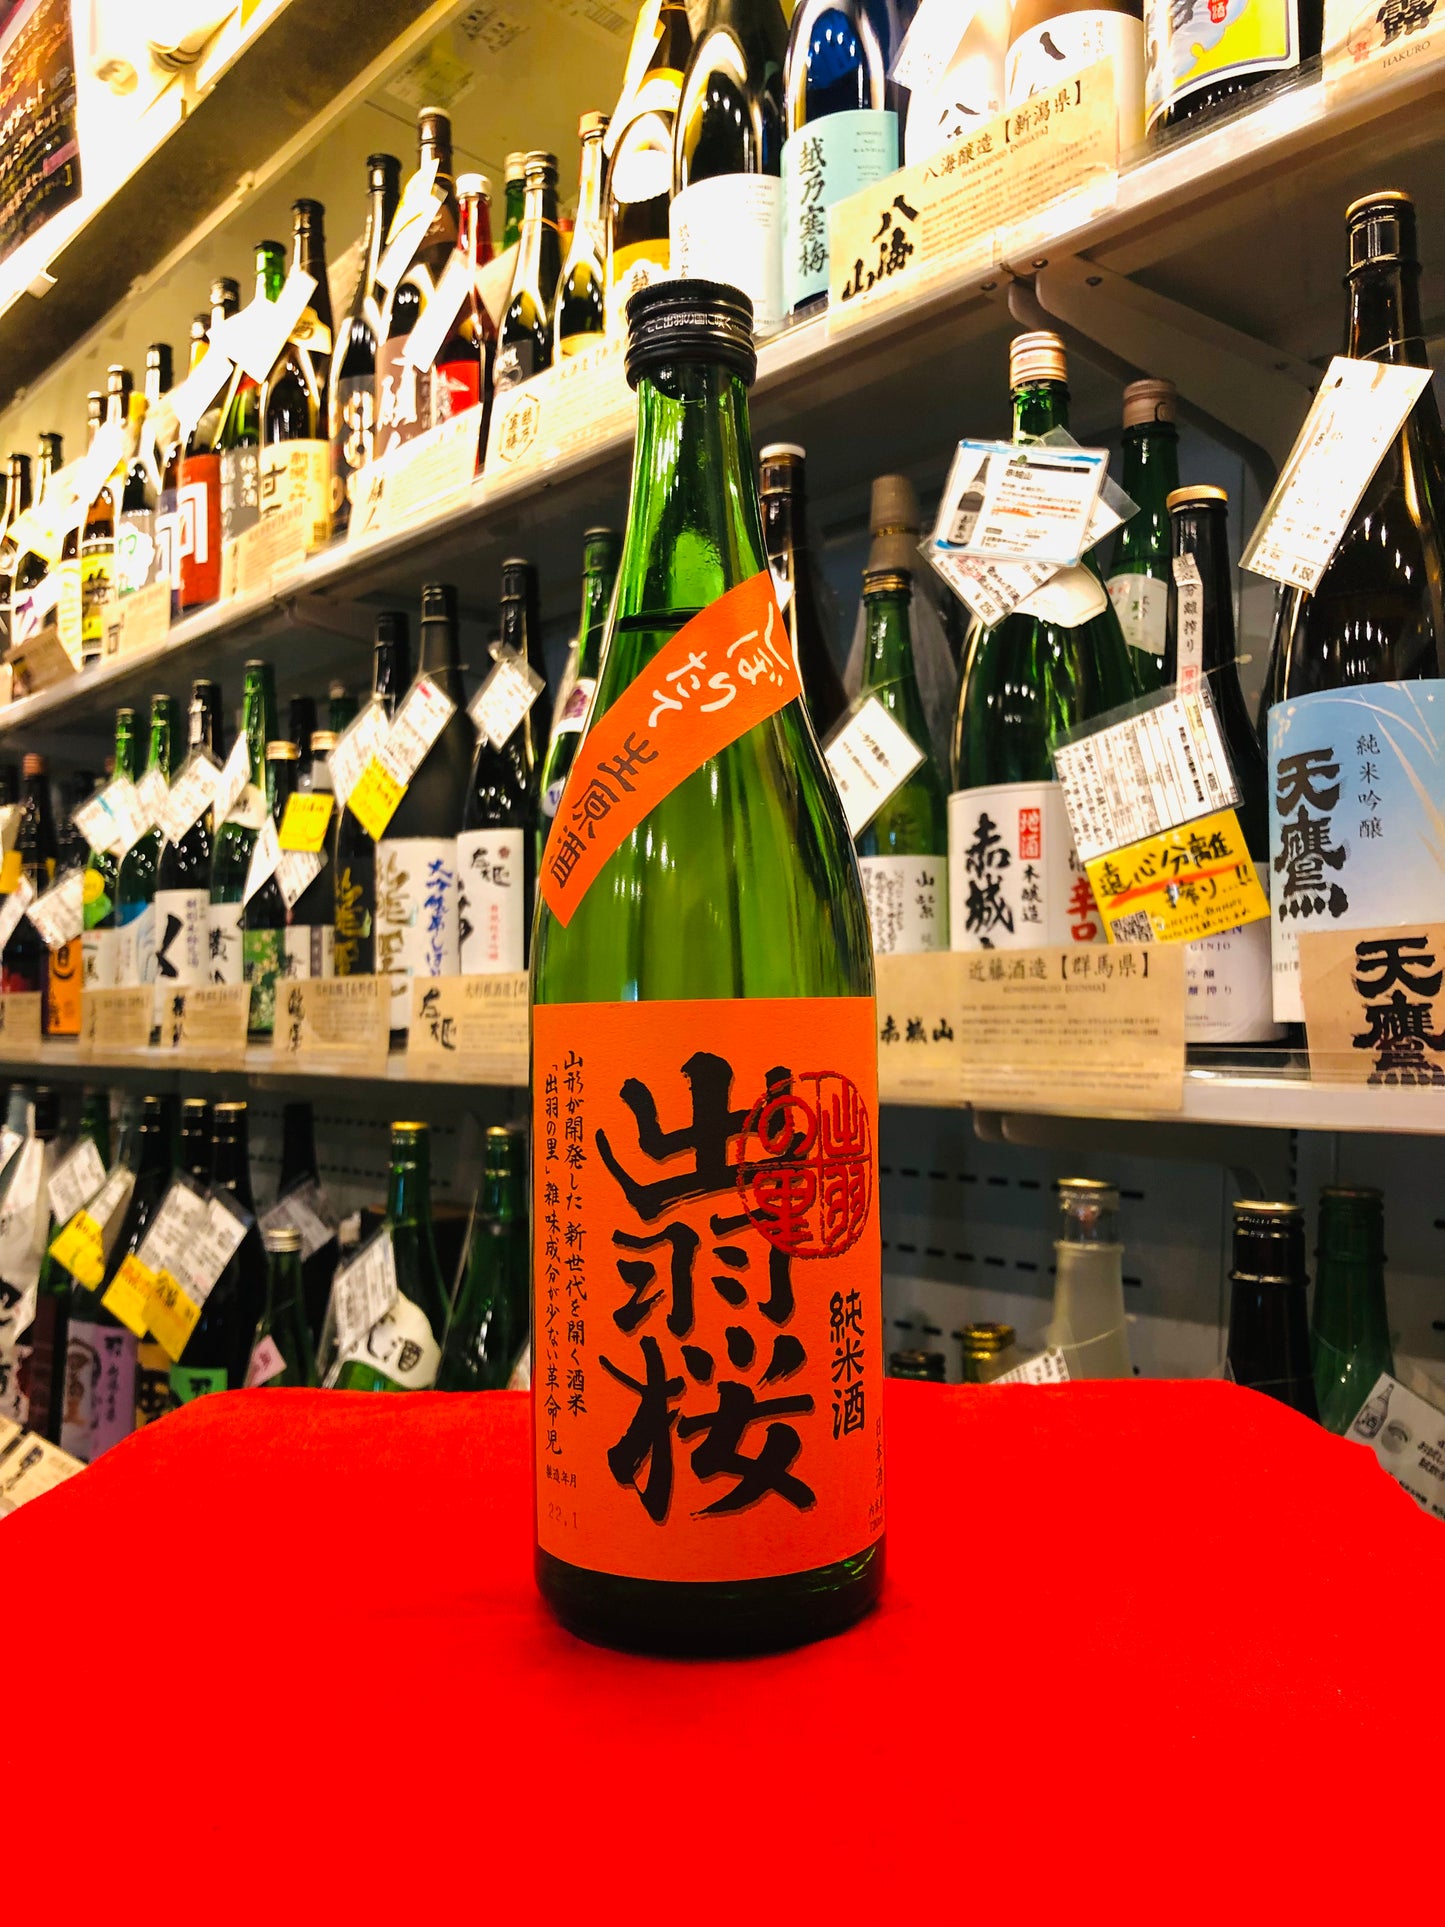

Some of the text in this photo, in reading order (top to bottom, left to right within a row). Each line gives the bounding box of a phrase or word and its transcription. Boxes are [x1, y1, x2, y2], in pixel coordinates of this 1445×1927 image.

[1382, 40, 1431, 69] HAKURO
[799, 137, 829, 277] 越乃寒梅
[842, 194, 920, 301] 八海山
[648, 601, 790, 728] しぼりたて
[549, 731, 660, 889] 生原酒
[1019, 808, 1041, 861] 地酒
[1274, 748, 1349, 922] 天鷹
[1357, 734, 1384, 839] 純米吟醸
[964, 812, 1015, 949] 赤城
[1100, 831, 1234, 898] 遠心分離
[967, 950, 1150, 984] 近藤酒造【群馬県】
[1190, 941, 1231, 953] GINJO
[880, 1014, 955, 1046] 赤城山
[1351, 935, 1445, 1085] 天鷹
[564, 1050, 588, 1417] 山形が開発した 新世代を開く酒米
[595, 1051, 815, 1524] 出羽桜
[829, 1288, 865, 1440] 純米酒
[545, 1463, 578, 1489] 製造年月
[547, 1501, 579, 1530] 22.1
